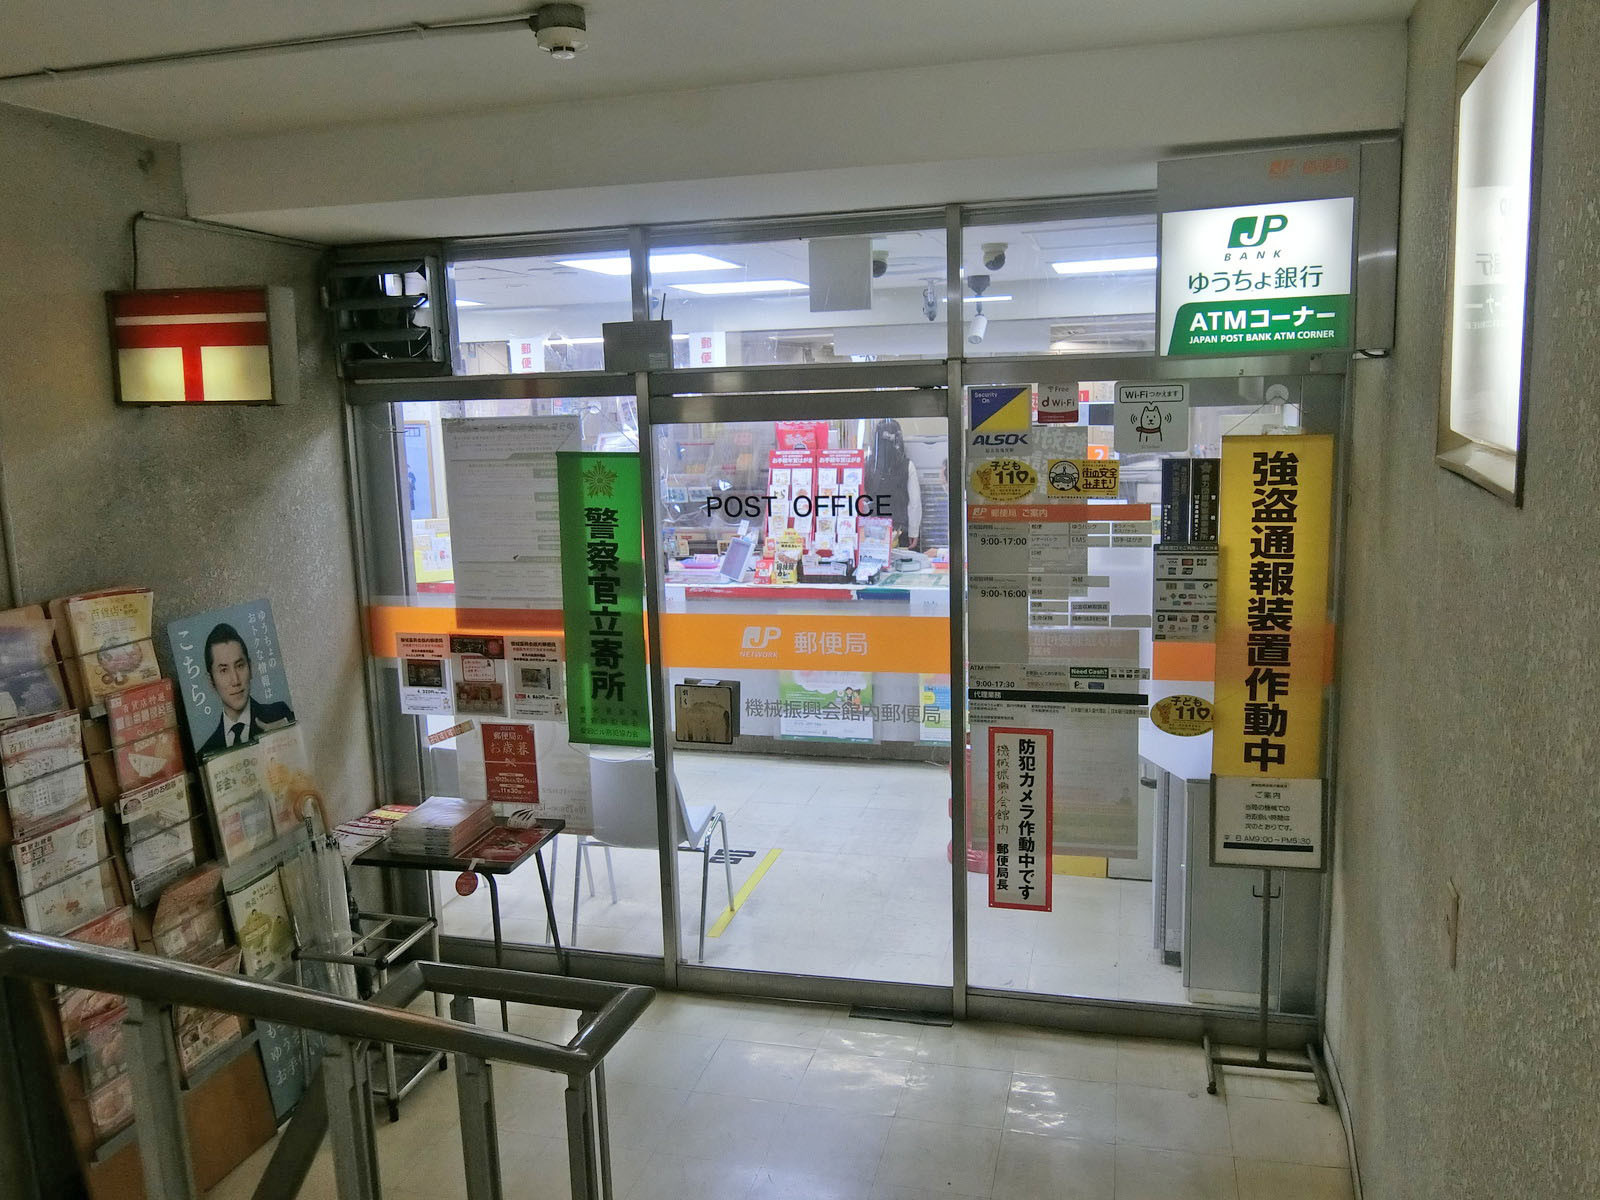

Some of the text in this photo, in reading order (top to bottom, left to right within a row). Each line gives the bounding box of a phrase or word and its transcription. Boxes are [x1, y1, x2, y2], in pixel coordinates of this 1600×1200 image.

[1224, 250, 1282, 261] BANK
[1188, 265, 1324, 294] ゆうちょ銀行
[1189, 306, 1335, 331] ATMコーナー
[1189, 330, 1335, 345] JAPAN POST BANK ATM CORNER
[1052, 399, 1075, 407] Wi-Fi
[972, 434, 1028, 445] ALSOK
[990, 461, 1021, 471] 子ども
[1082, 467, 1118, 479] 街の安全
[1082, 478, 1117, 490] みまもり
[706, 494, 893, 518] POST OFFICE
[1022, 508, 1048, 518] ご案内
[980, 537, 1027, 546] 9:00-17:00
[980, 589, 1027, 598] 9:00-16:00
[584, 507, 627, 702] 警察官立寄所
[1243, 451, 1299, 772] 強盗通報装置作動中
[258, 611, 276, 668] ゆうちょの
[793, 632, 868, 656] 郵便局
[247, 613, 274, 699] おトクな情報は
[178, 630, 212, 715] こちら。
[976, 680, 1015, 688] 9:00-17:30
[1171, 696, 1203, 706] 子ども
[745, 698, 941, 724] 機械振興会館内郵便局
[493, 731, 524, 741] 郵便局の
[490, 741, 530, 756] お歳暮
[1255, 791, 1281, 799] ご案内
[1018, 738, 1036, 901] 防犯カメラ作動中です
[1245, 823, 1292, 832] 次のとおりです。
[996, 843, 1009, 891] 郵便局長
